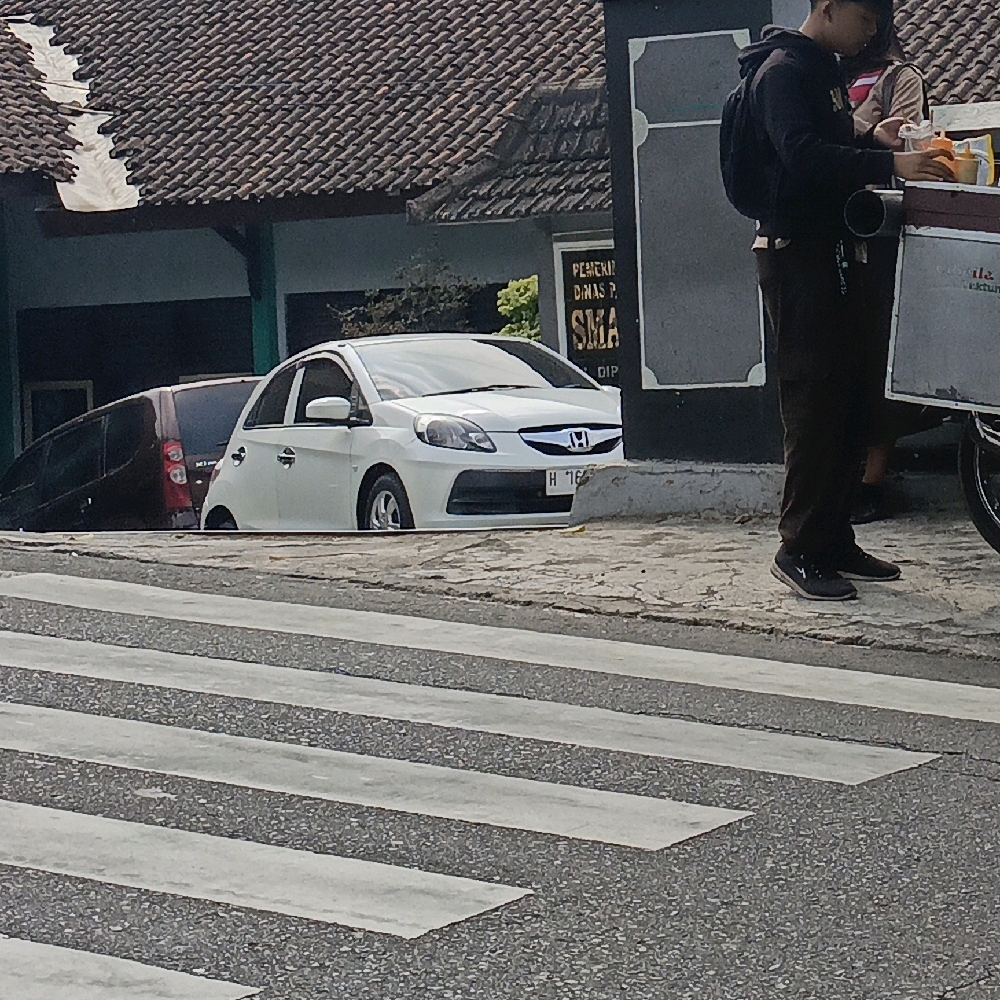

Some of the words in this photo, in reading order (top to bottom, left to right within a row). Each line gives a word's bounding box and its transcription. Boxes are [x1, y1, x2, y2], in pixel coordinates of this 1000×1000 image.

[573, 282, 606, 301] DINAS
[608, 281, 618, 300] P
[571, 306, 620, 351] SMA
[549, 471, 557, 487] H
